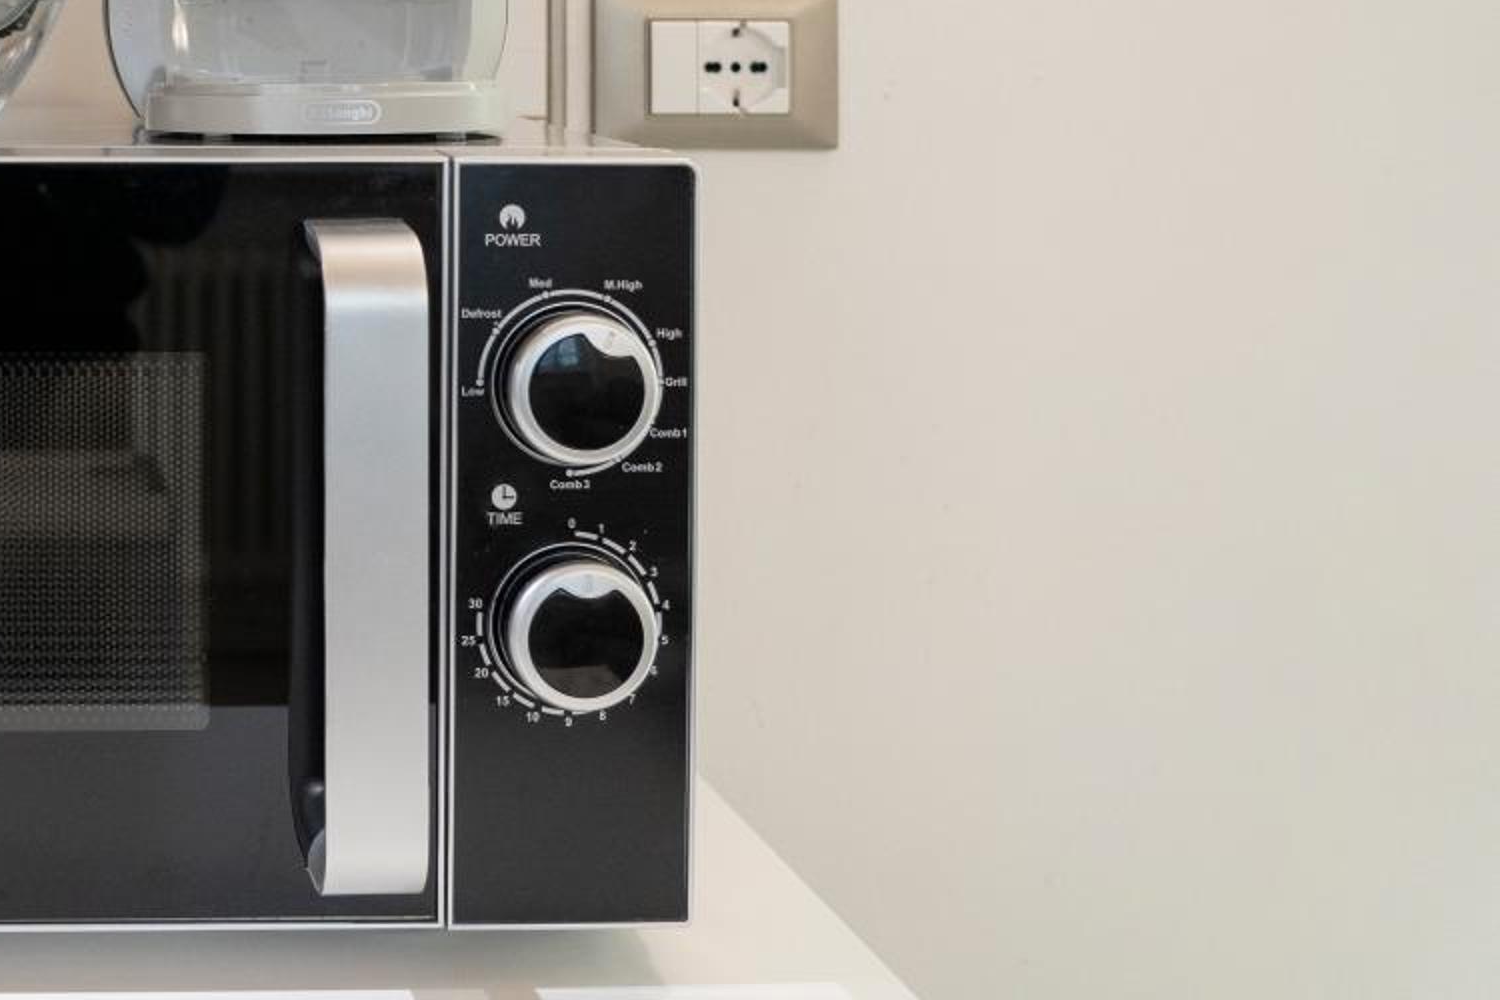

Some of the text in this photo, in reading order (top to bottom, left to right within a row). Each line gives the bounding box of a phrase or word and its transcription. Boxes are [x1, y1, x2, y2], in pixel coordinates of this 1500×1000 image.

[485, 233, 541, 247] POWER
[529, 278, 553, 288] Med
[604, 279, 643, 292] M.High
[461, 308, 502, 319] Defrost
[657, 328, 683, 340] High
[665, 377, 688, 387] Grill
[461, 386, 485, 397] Low
[488, 512, 523, 525] TIME
[567, 517, 576, 529] 0
[629, 540, 637, 551] 2
[650, 566, 658, 577] 3
[469, 598, 483, 609] 30
[661, 599, 670, 610] 4
[461, 635, 476, 647] 25
[661, 635, 669, 645] 5
[475, 667, 489, 678] 20
[497, 695, 510, 706] 15
[527, 711, 540, 722] 10
[565, 716, 573, 727] 9
